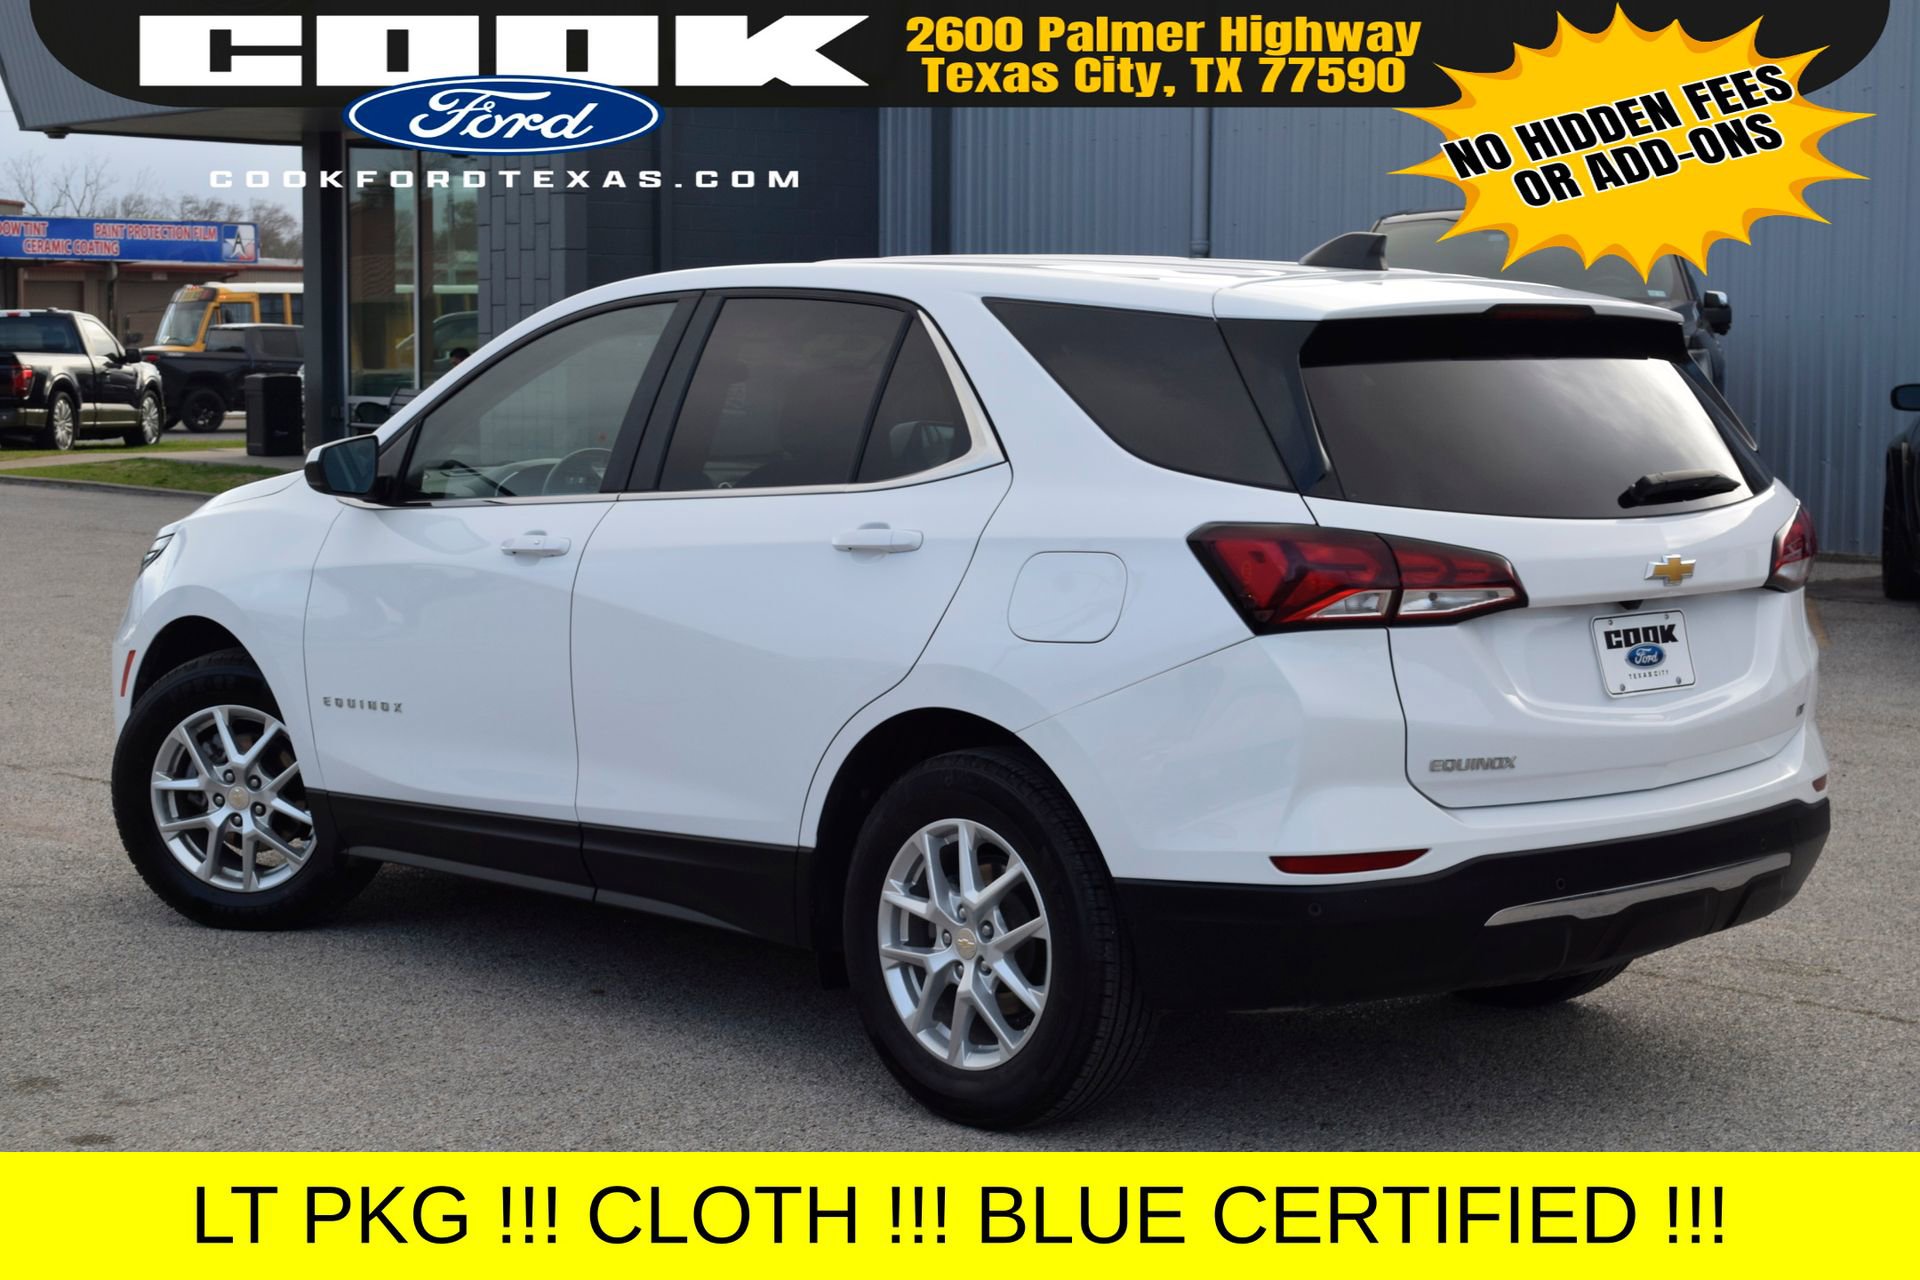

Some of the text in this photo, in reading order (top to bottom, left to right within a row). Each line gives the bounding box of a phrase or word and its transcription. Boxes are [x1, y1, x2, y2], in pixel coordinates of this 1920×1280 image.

[23, 222, 48, 237] TINT
[93, 223, 125, 240] PAINT
[127, 224, 192, 241] PROTECTION
[192, 225, 218, 242] FILM
[23, 239, 120, 256] CERAMIC COATING
[1604, 624, 1679, 650] COOK
[1634, 648, 1659, 664] Ford
[322, 696, 403, 713] EQUINOX
[1428, 756, 1518, 772] EQUINOX
